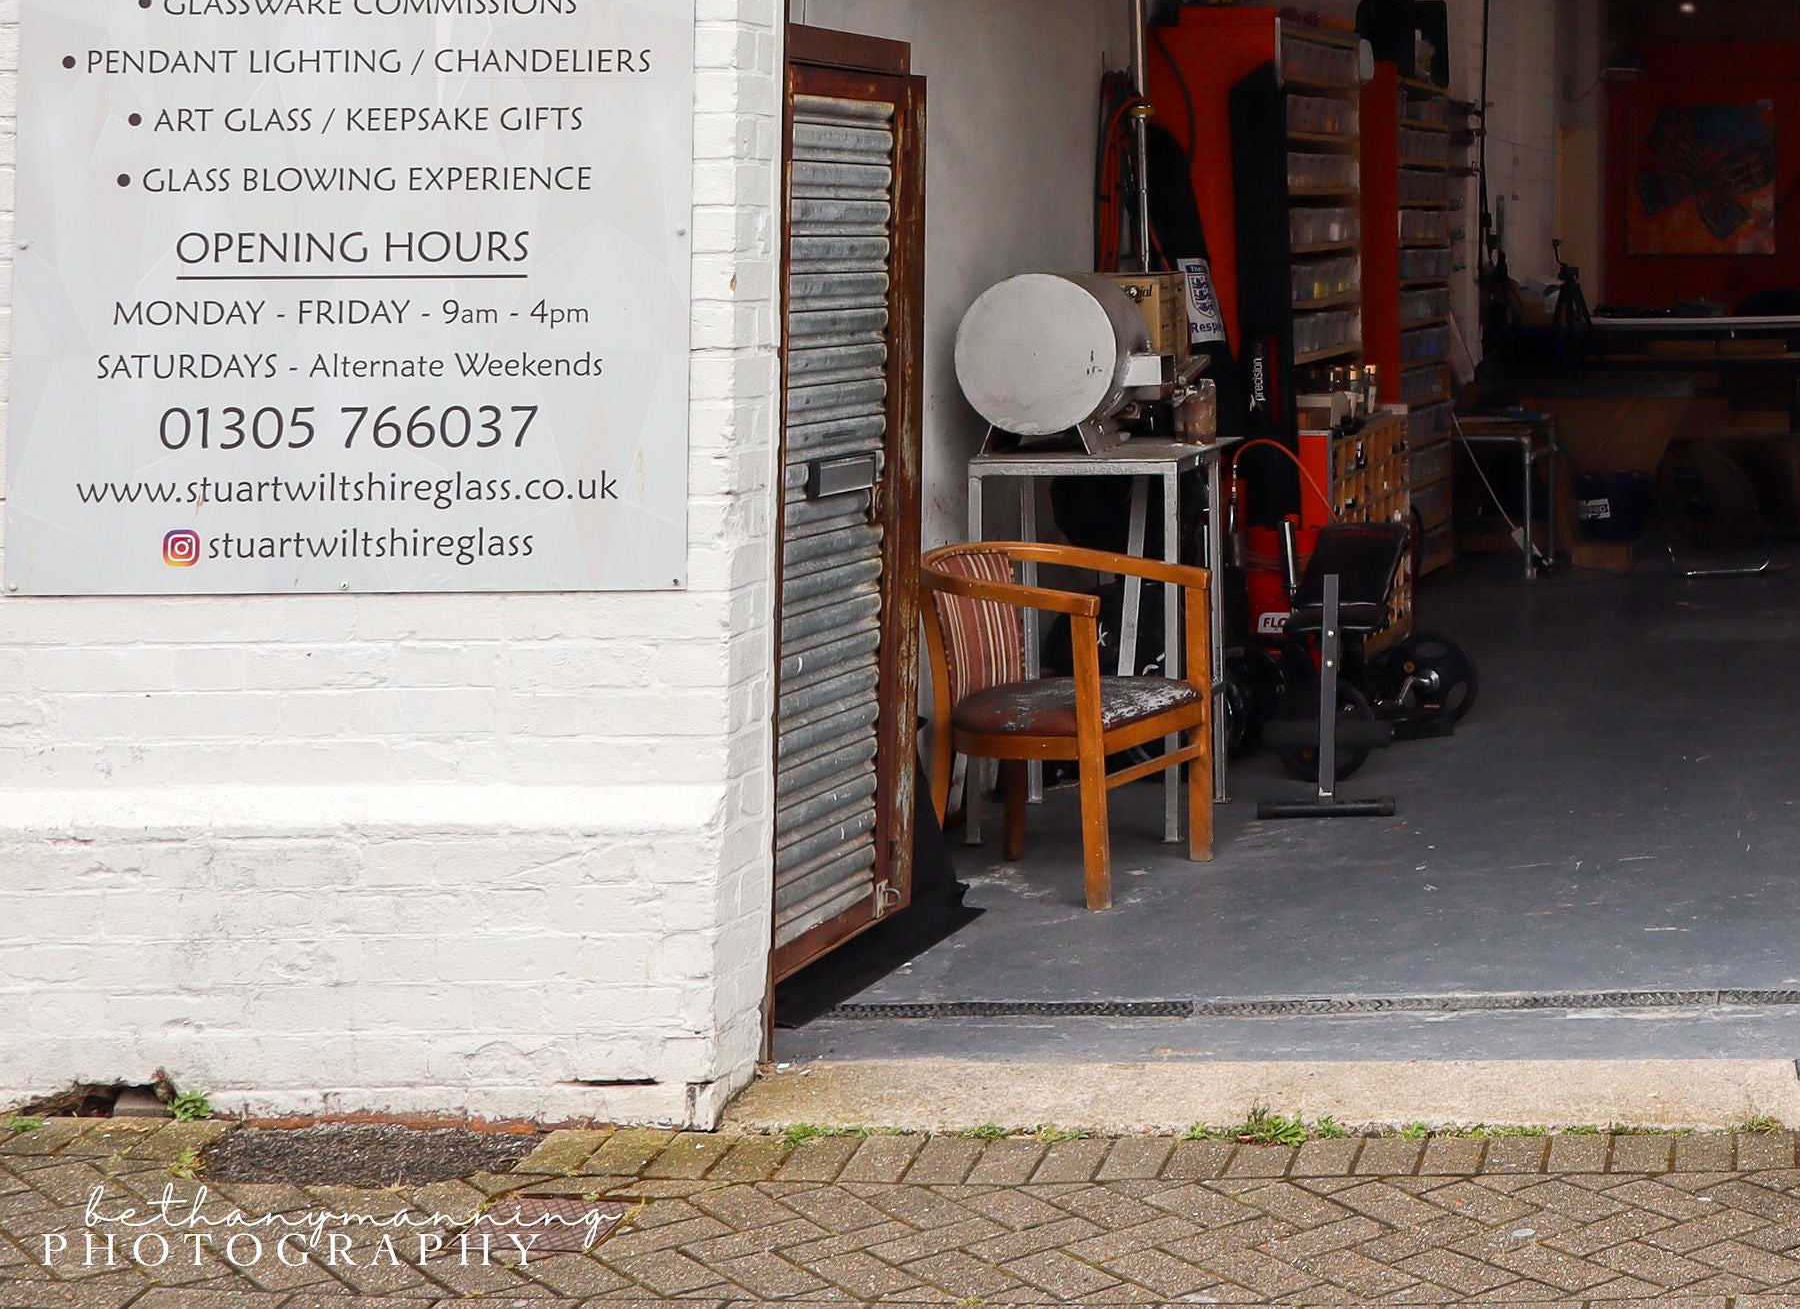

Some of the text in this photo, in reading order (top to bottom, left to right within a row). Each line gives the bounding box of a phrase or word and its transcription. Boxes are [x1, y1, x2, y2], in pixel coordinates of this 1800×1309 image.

[87, 48, 651, 76] PENDANT LIGHTING / CHANDELIERS
[153, 106, 583, 135] ART GLASS / KEEPSAKE GIFTS
[142, 166, 592, 193] GLASS BLOWING EXPERIENCE
[176, 230, 530, 264] OPENING HOURS
[113, 300, 266, 326] MONDAY
[298, 299, 411, 325] FRIDAY
[442, 299, 498, 325] 9am
[530, 298, 589, 330] 4pm
[97, 353, 278, 380] SATURDAYS
[309, 352, 444, 378] Alternate
[454, 351, 603, 378] Weekends
[159, 404, 539, 450] 01305 766037
[76, 469, 619, 510] www.stuartwiltshireglass.co.uk
[208, 526, 534, 566] stuartwiltshireglass
